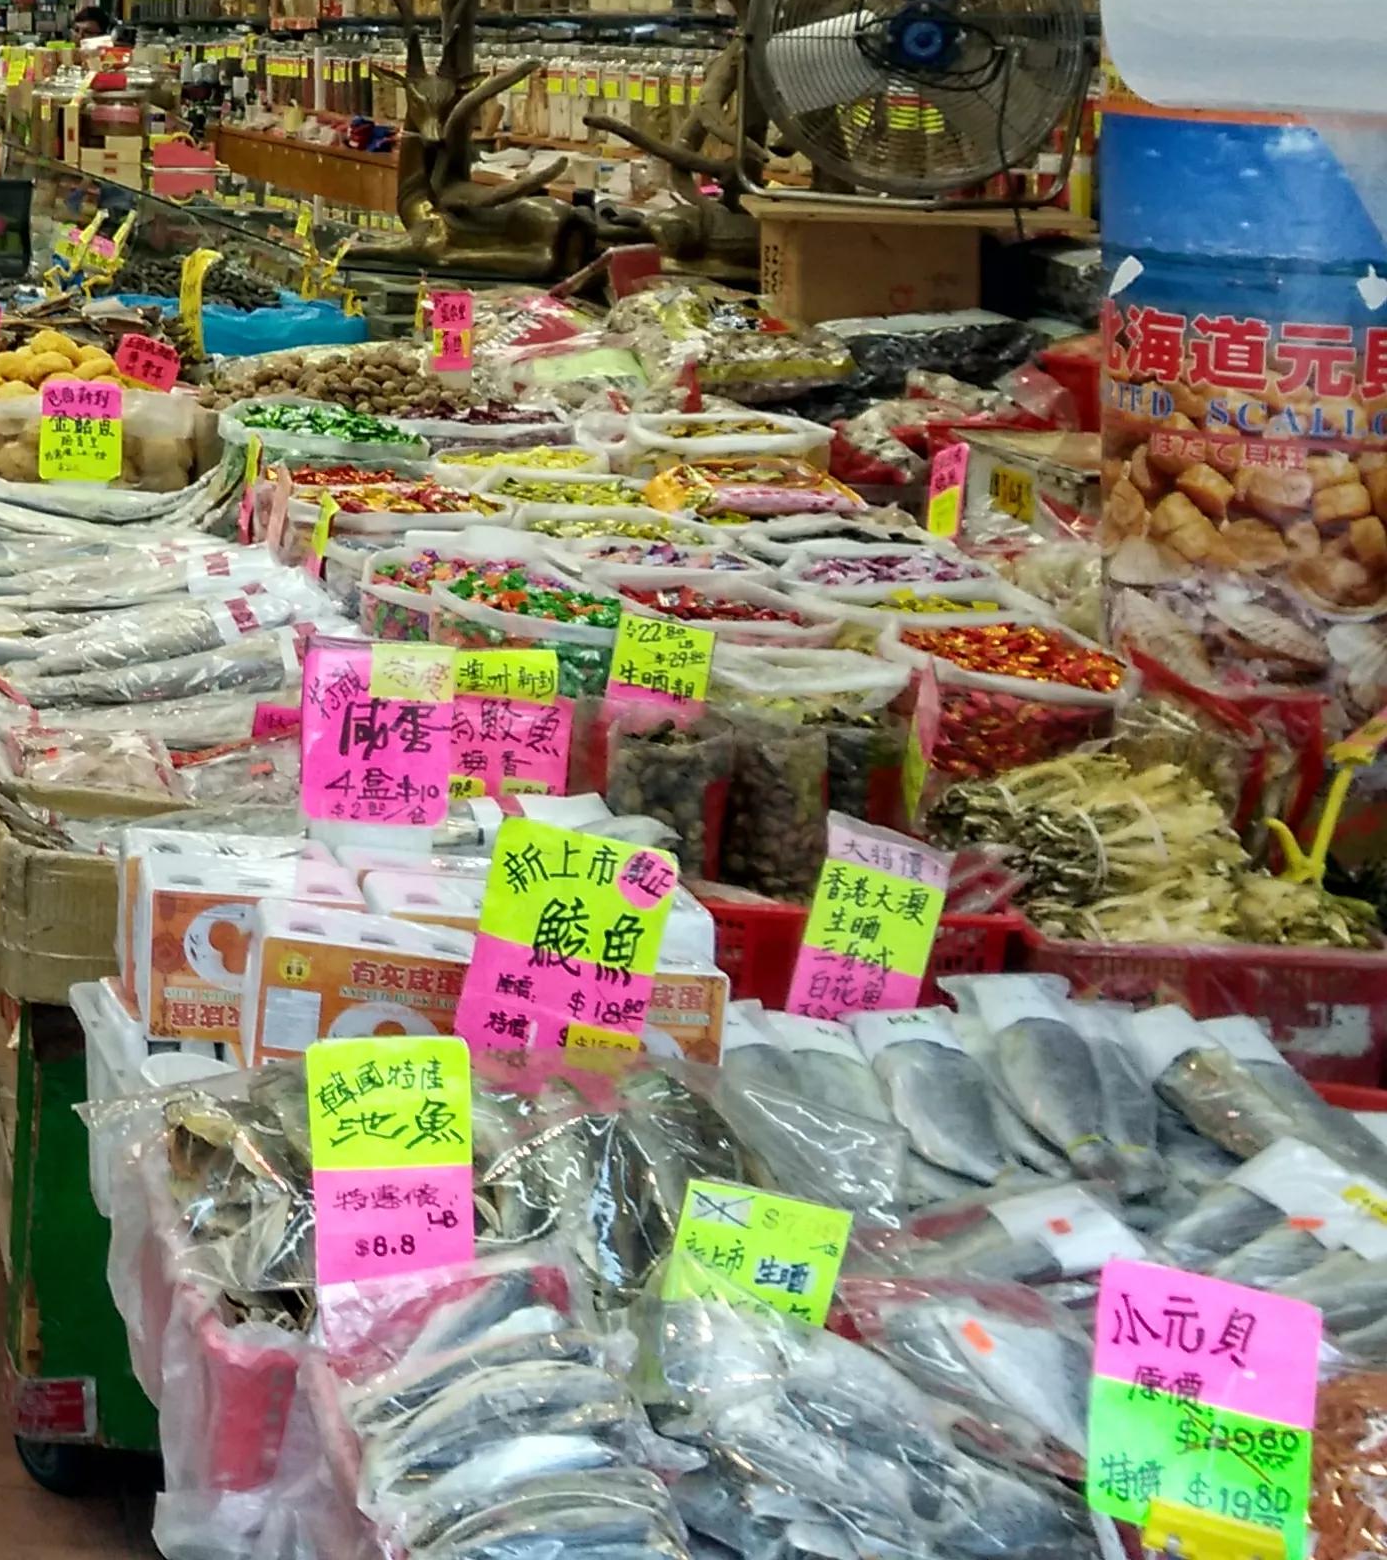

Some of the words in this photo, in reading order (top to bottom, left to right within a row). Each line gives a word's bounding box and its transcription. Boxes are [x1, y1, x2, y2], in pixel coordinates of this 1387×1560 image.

[338, 699, 452, 761] 咸蛋
[502, 840, 620, 894] 新上市
[823, 866, 930, 927] 香港大澳
[353, 1232, 417, 1258] $8.8
[1110, 1292, 1257, 1369] 小元貝
